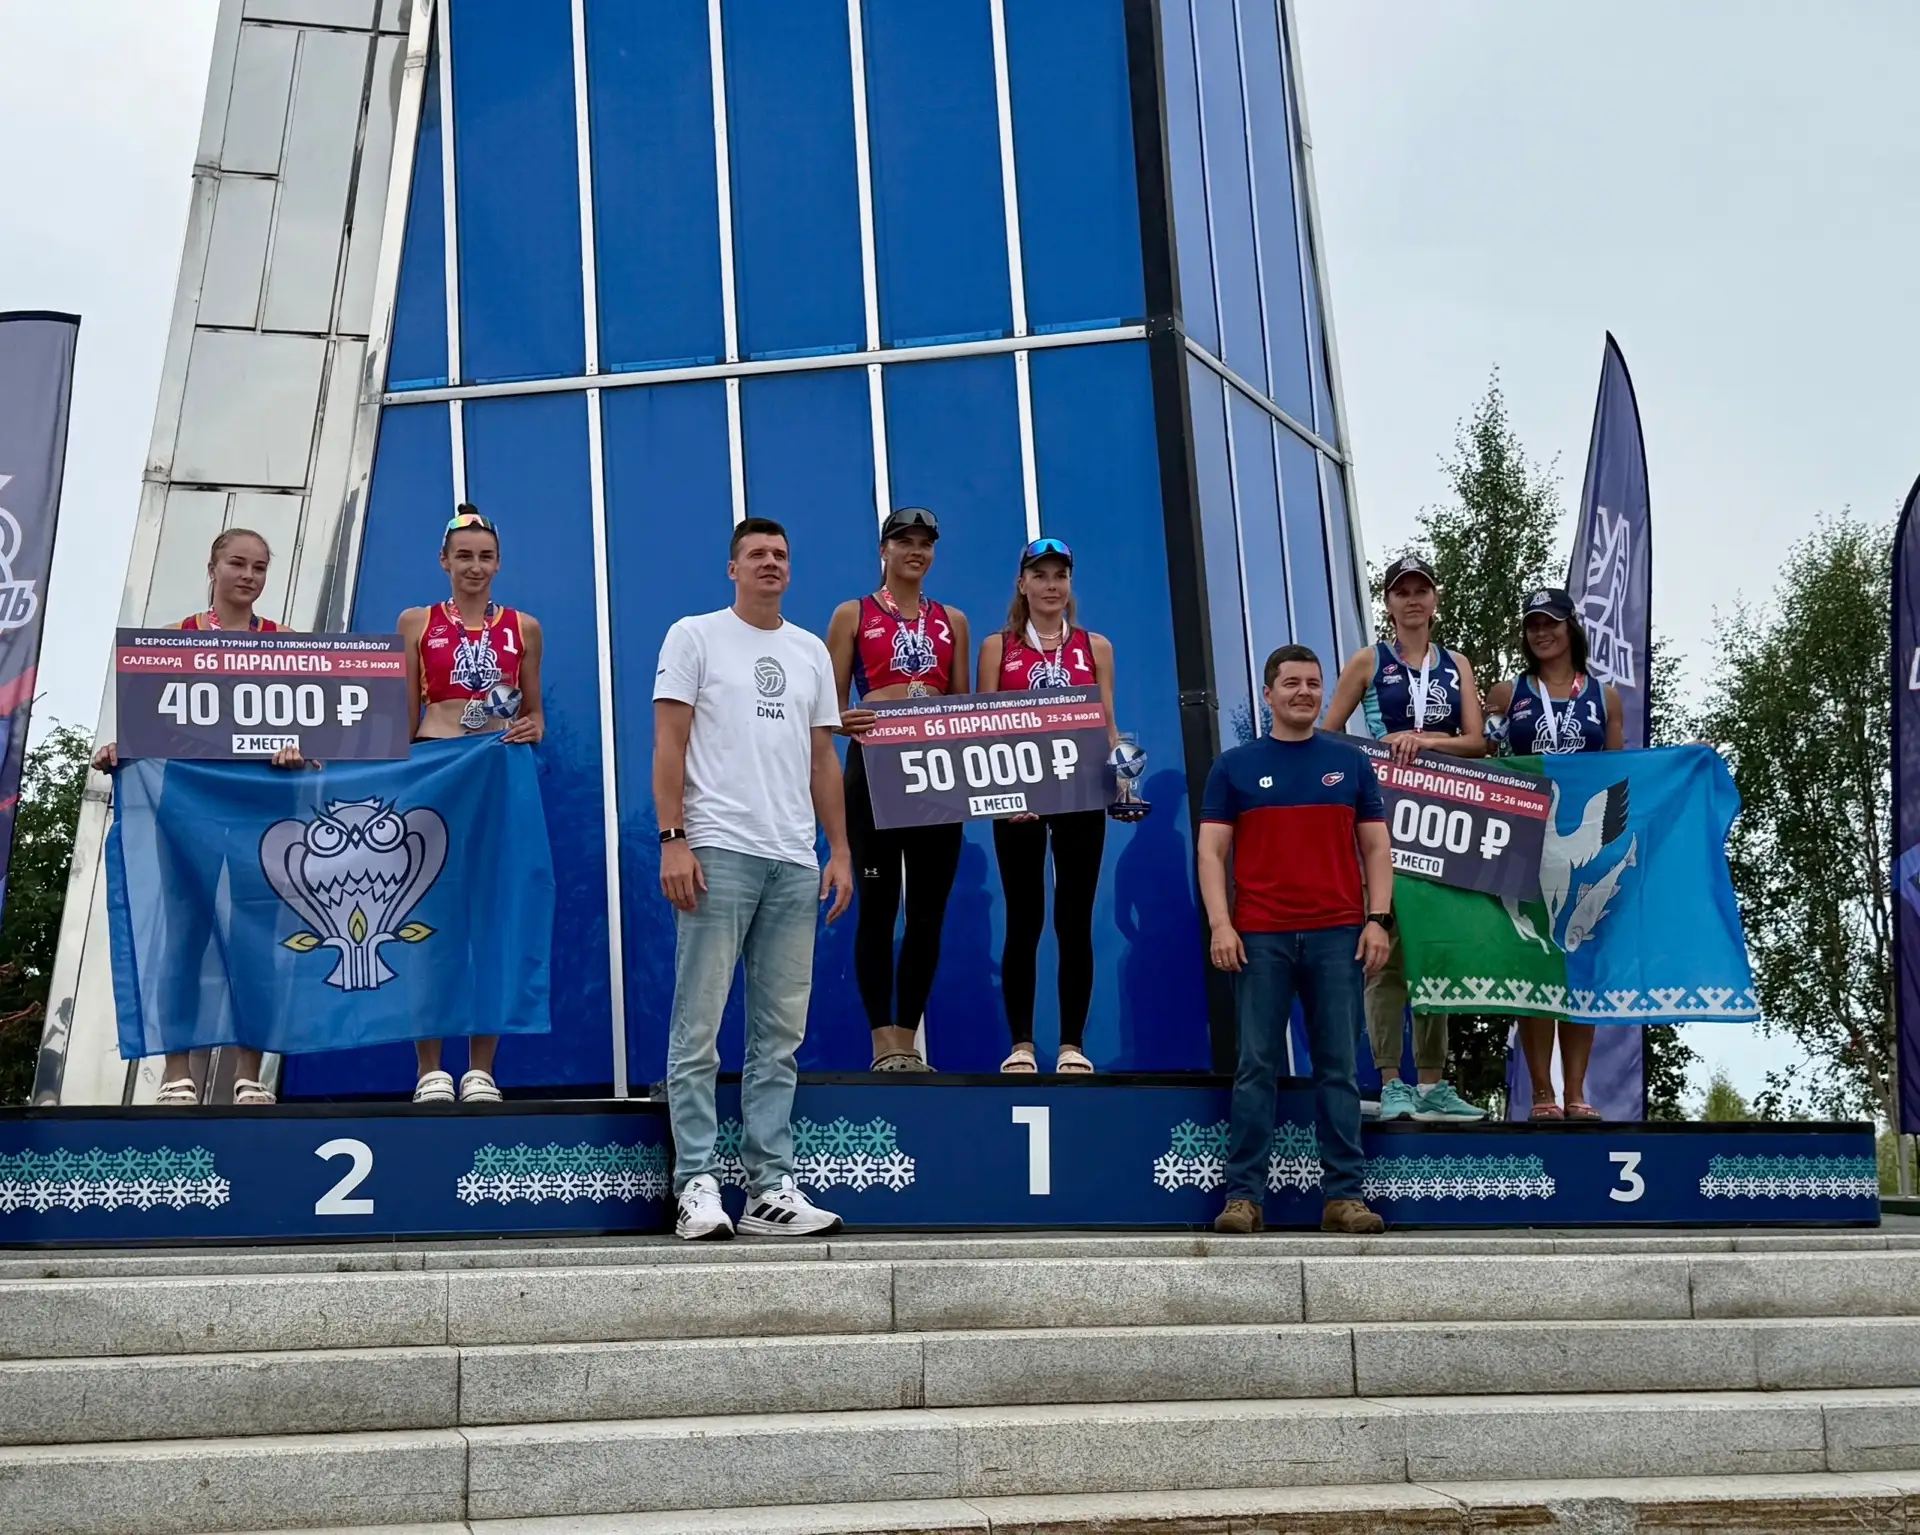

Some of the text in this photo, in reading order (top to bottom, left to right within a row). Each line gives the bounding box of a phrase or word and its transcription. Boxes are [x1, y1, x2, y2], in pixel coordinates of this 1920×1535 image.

[135, 637, 391, 651] ВСЕРОССИЙСКИЙ ТУРНИР ПО ПЛЯЖНОМУ ВОЛЕЙБОЛУ
[502, 627, 519, 655] 1
[934, 619, 951, 644] 2
[122, 653, 400, 672] САЛЕХАРД 66 ПАРАЛЛЕЛЬ 25-26 июля
[891, 656, 937, 669] ПАРЕЛЬ
[1072, 648, 1089, 671] 1
[451, 669, 501, 683] ПАРЕЛЬ
[1444, 668, 1460, 691] 2
[157, 682, 219, 726] 40
[233, 683, 325, 727] 000
[757, 706, 785, 720] DNA
[876, 694, 1087, 717] СЕРОССИЙСКИЙ ТУРНИР ПО ПЛЯЖНОМУ ВОЛЕЙБОЛУ
[1585, 700, 1601, 725] 1
[866, 711, 1100, 737] САЛЕХАРД 66 ПАРАЛЛЕЛЬ 25-26 июля
[236, 737, 246, 750] 2
[900, 748, 955, 794] 50
[962, 741, 1044, 789] 000
[1424, 760, 1437, 769] ПО
[1438, 763, 1487, 780] ПЛЯЖНОМУ
[1487, 773, 1537, 791] ВОЛЕЙБОЛУ
[1392, 767, 1485, 802] ПАРАЛЛЕЛЬ
[1490, 792, 1516, 805] 25-26
[1517, 799, 1544, 811] июля
[973, 796, 1023, 812] 1 МЕСТО
[1392, 799, 1473, 854] 000
[1401, 853, 1440, 873] МЕСТО
[1012, 1106, 1050, 1195] 1
[314, 1138, 374, 1215] 2
[1609, 1152, 1645, 1202] 3
